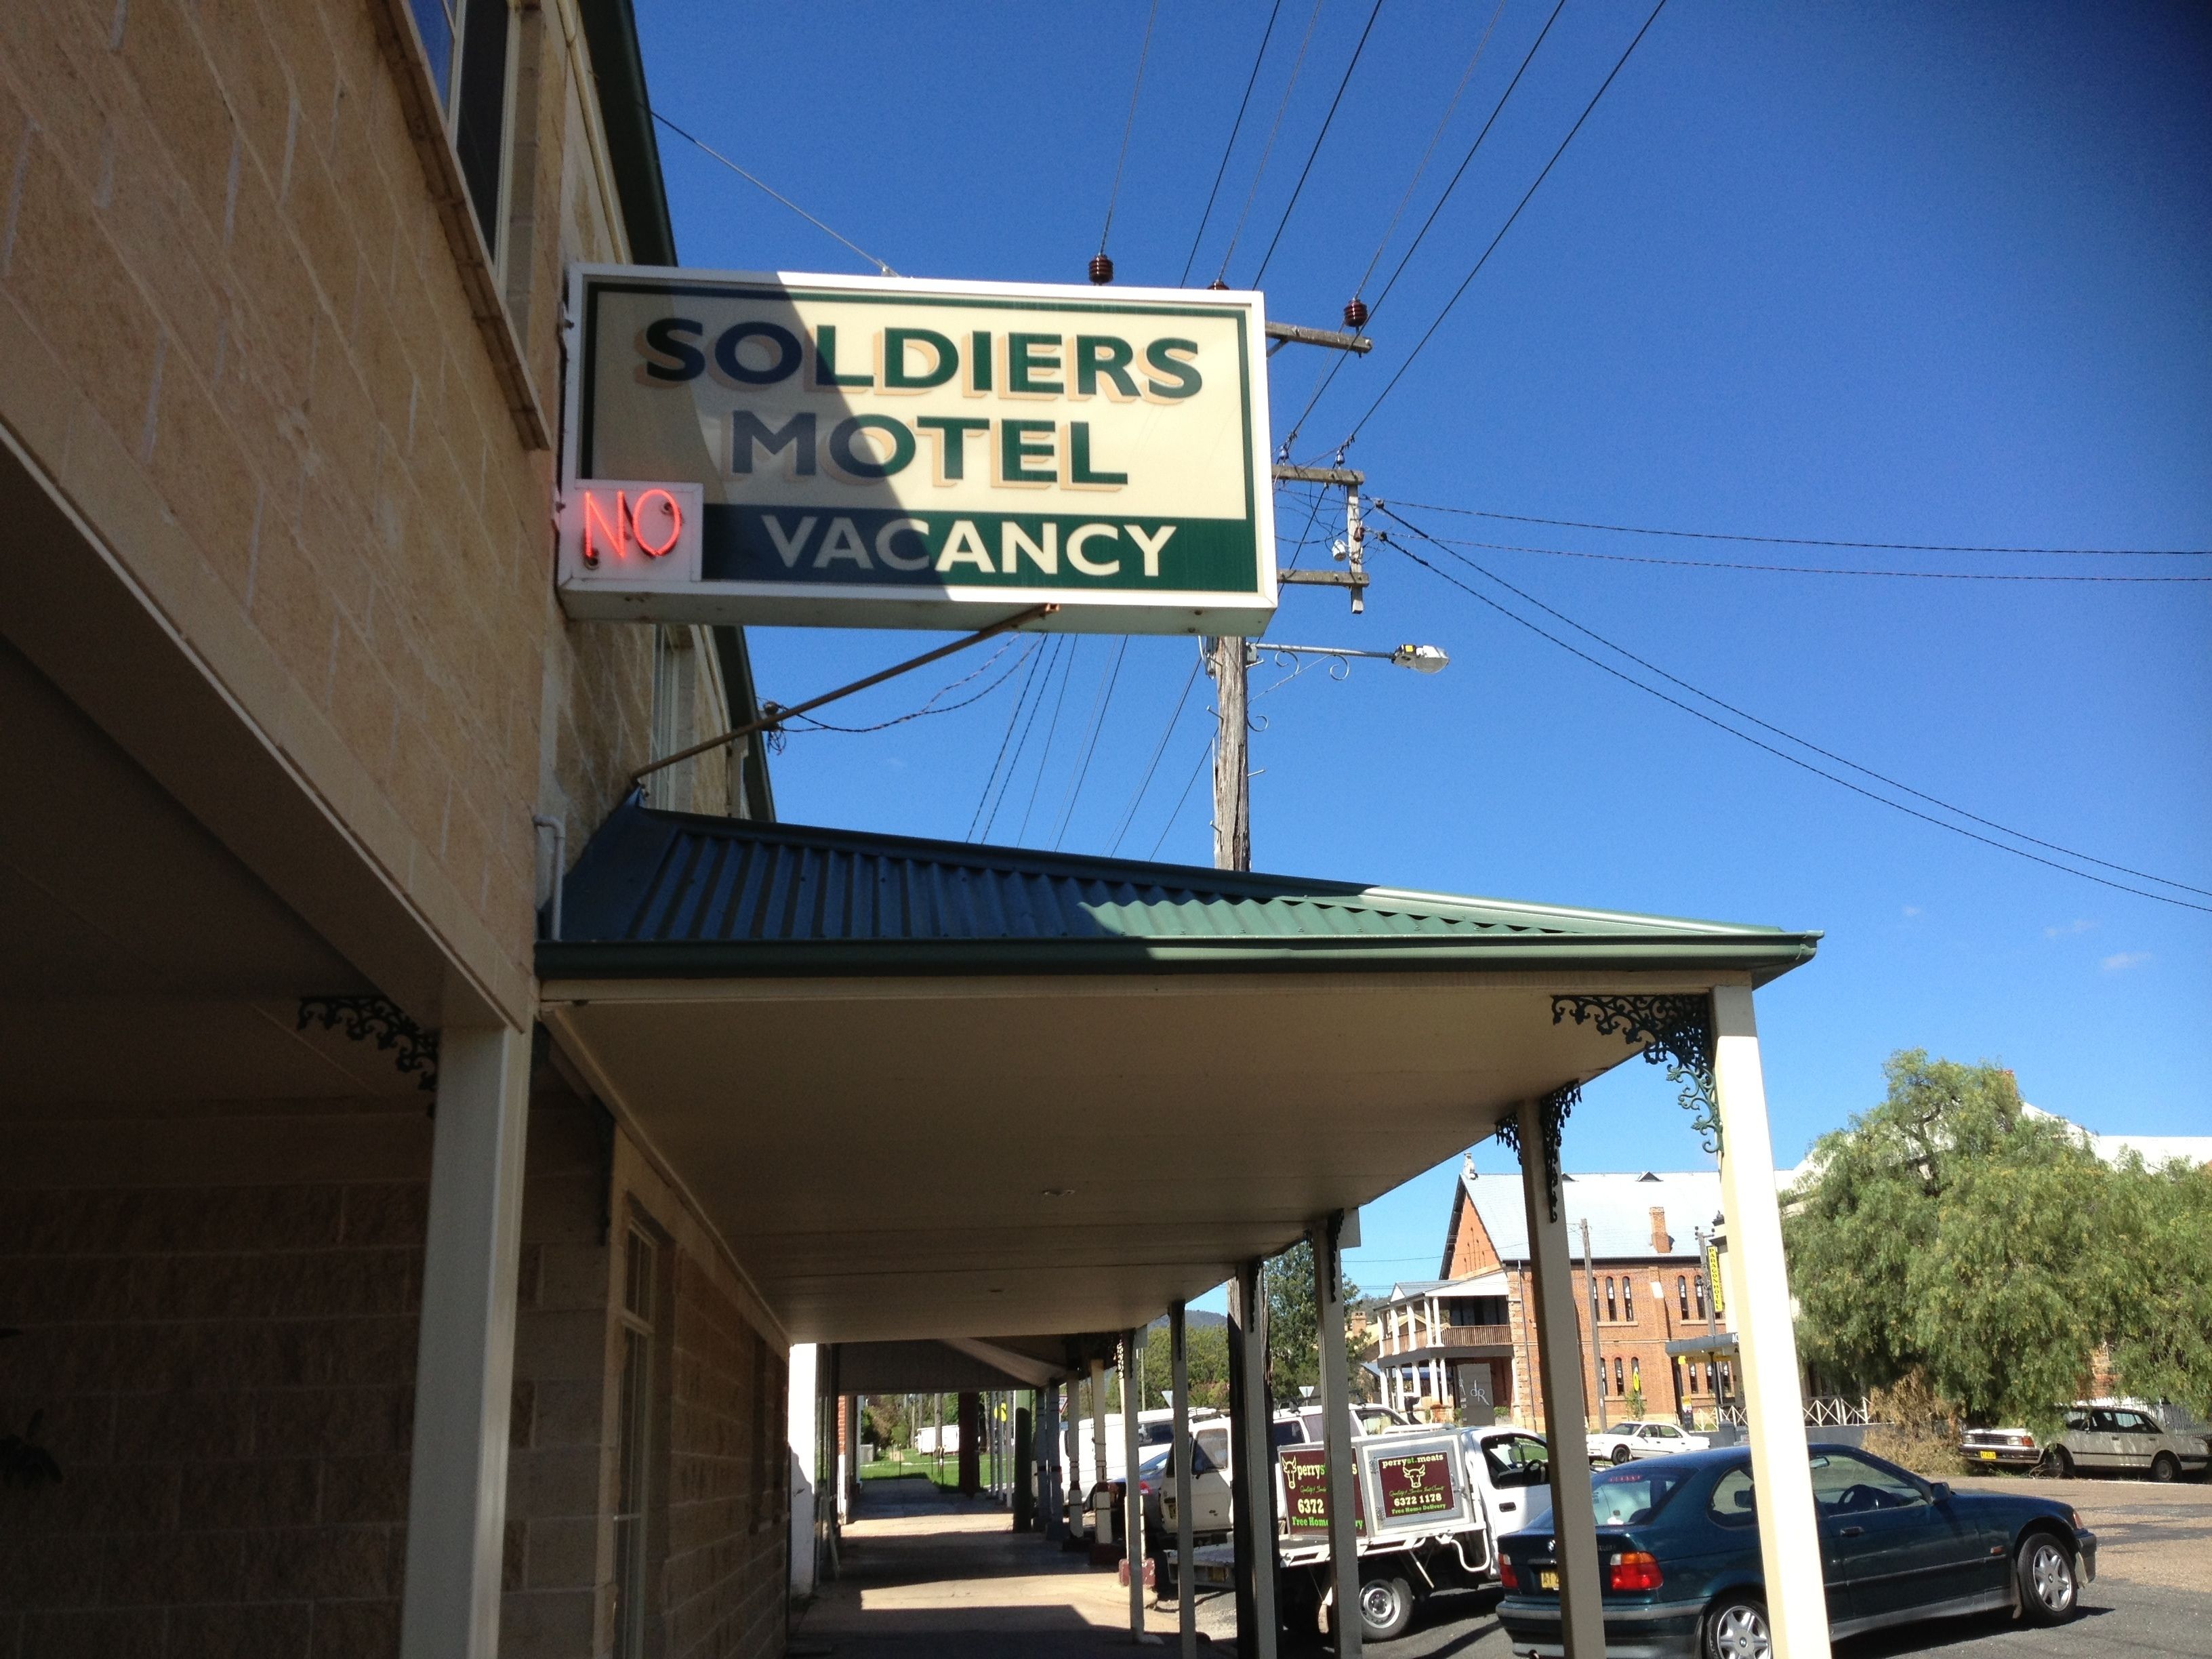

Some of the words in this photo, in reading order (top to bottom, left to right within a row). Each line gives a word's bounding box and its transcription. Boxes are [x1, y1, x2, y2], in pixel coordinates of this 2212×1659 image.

[644, 317, 1203, 401] SOLDIERS
[731, 409, 1128, 486] MOTEL
[583, 488, 682, 559] NO
[760, 514, 1177, 577] VACANCY
[1709, 1248, 1718, 1283] PARAGON
[1297, 1498, 1325, 1515] 6372
[1393, 1496, 1417, 1507] 6372
[1419, 1493, 1442, 1503] 1178
[1422, 1503, 1446, 1511] Delivery
[1292, 1516, 1308, 1525] Free
